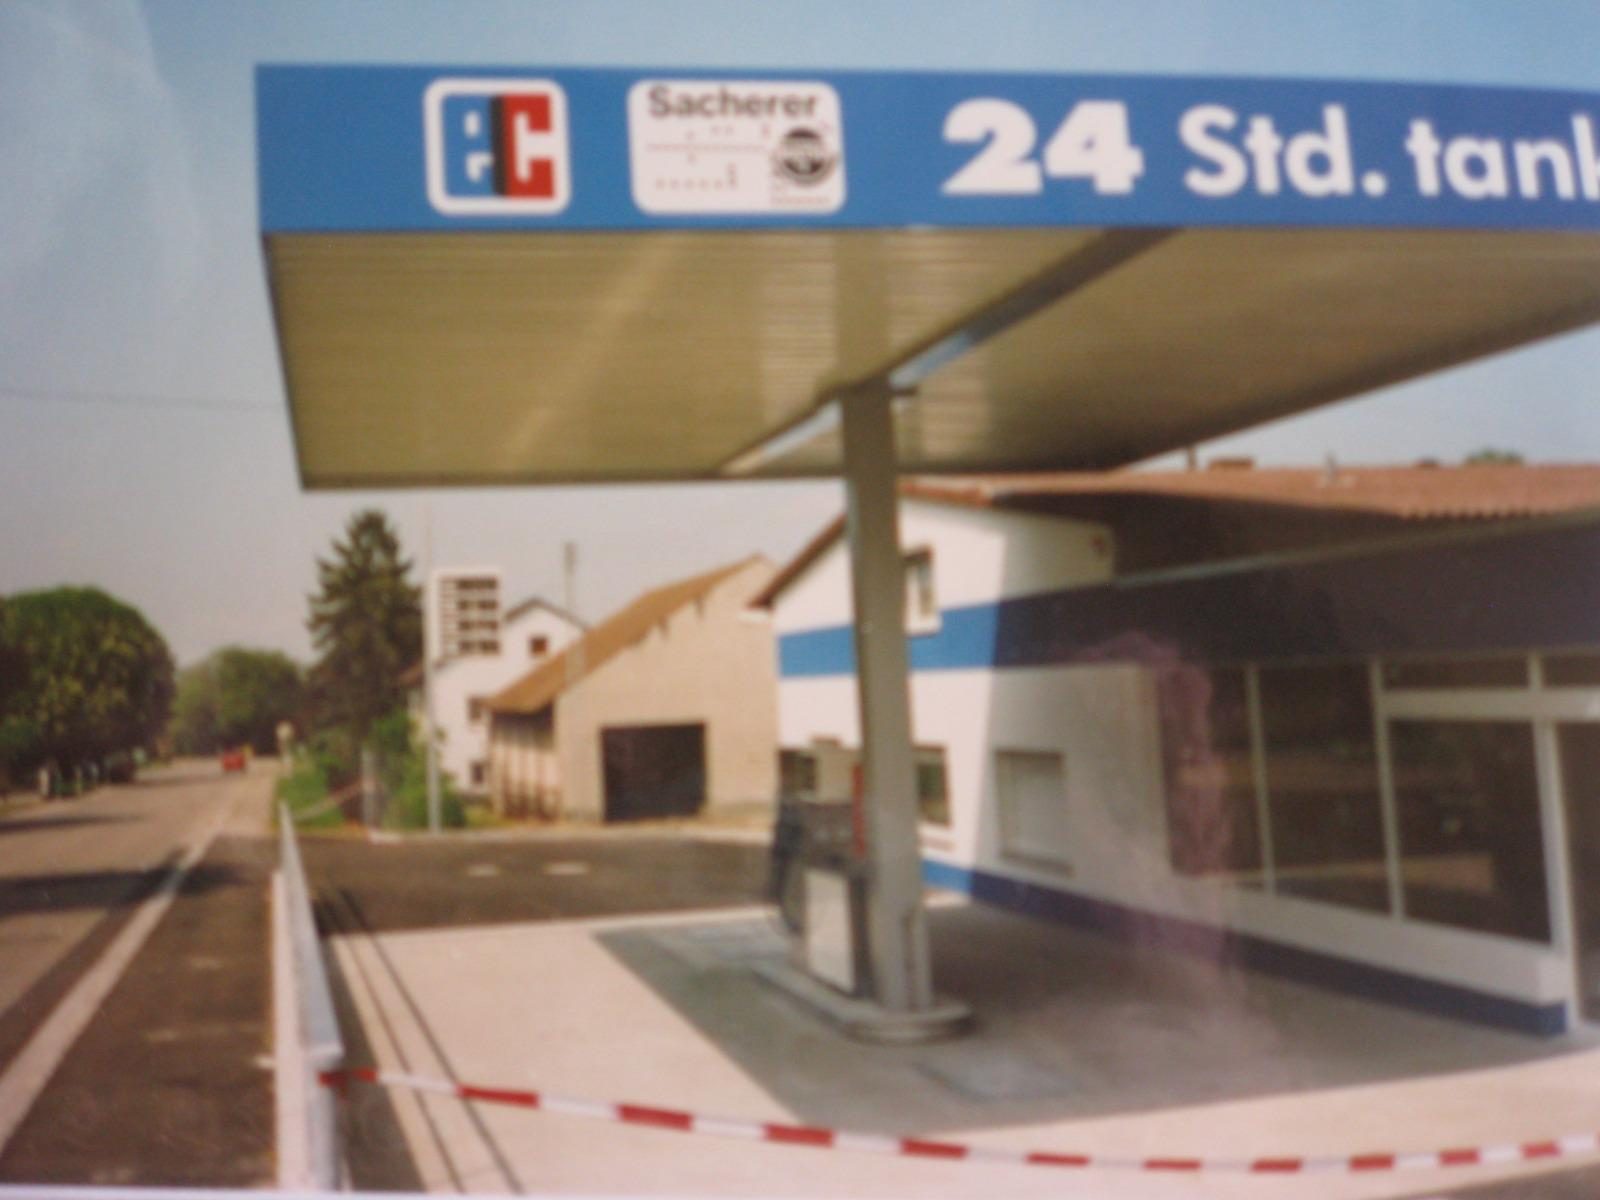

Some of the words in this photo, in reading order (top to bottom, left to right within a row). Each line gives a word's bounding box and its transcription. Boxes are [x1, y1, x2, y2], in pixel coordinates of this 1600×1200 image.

[648, 84, 818, 119] Sacherer
[942, 98, 1144, 195] 24
[1179, 104, 1387, 197] Std.
